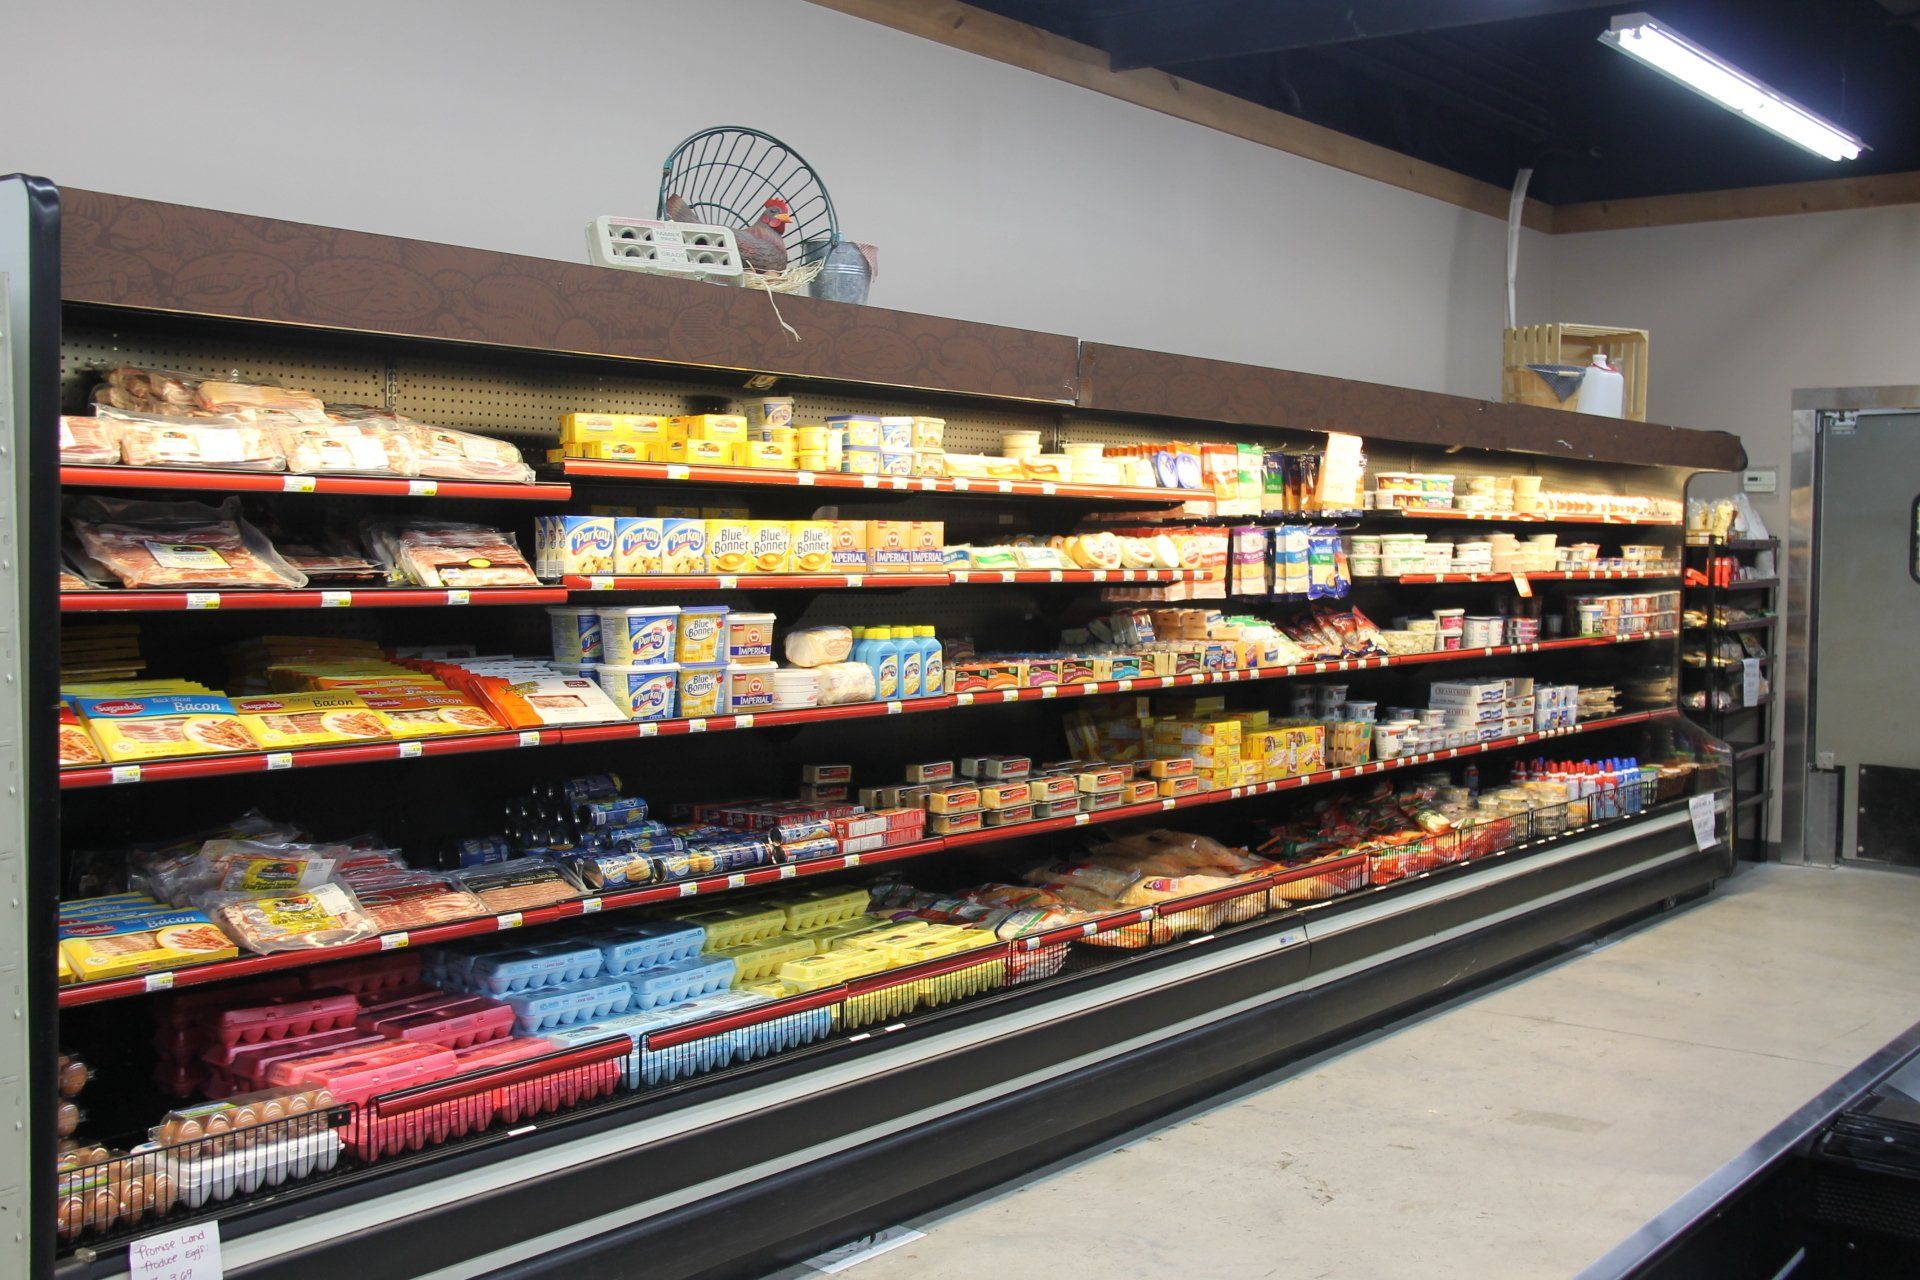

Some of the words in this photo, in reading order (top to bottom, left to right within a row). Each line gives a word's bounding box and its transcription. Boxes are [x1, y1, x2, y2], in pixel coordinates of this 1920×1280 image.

[576, 526, 610, 551] Parkay
[626, 527, 659, 552] Parkay
[671, 528, 702, 552] Parkay
[722, 529, 742, 541] Blue
[760, 530, 780, 542] Blue
[804, 530, 822, 542] Blue
[714, 542, 749, 554] Bonnet
[754, 542, 787, 554] Bonnet
[798, 542, 830, 554] Bonnet
[832, 552, 865, 562] MPERIAL
[877, 552, 909, 562] IMPERIAL
[912, 552, 942, 562] IMPERIAL
[694, 620, 709, 629] Blue
[688, 626, 714, 638] Bonnet
[637, 632, 663, 649] Parkay
[739, 646, 768, 655] IMPERIAL
[693, 676, 708, 684] Blue
[687, 682, 714, 693] Bonnet
[312, 698, 354, 708] Bacon
[636, 690, 663, 704] Parkay
[740, 695, 769, 704] IMPERIAL
[94, 704, 144, 714] Sugardale
[174, 702, 222, 712] Bacon
[240, 701, 283, 711] Sugardale
[148, 915, 197, 928] Bacon
[135, 1240, 175, 1260] Promise
[181, 1230, 205, 1245] Land
